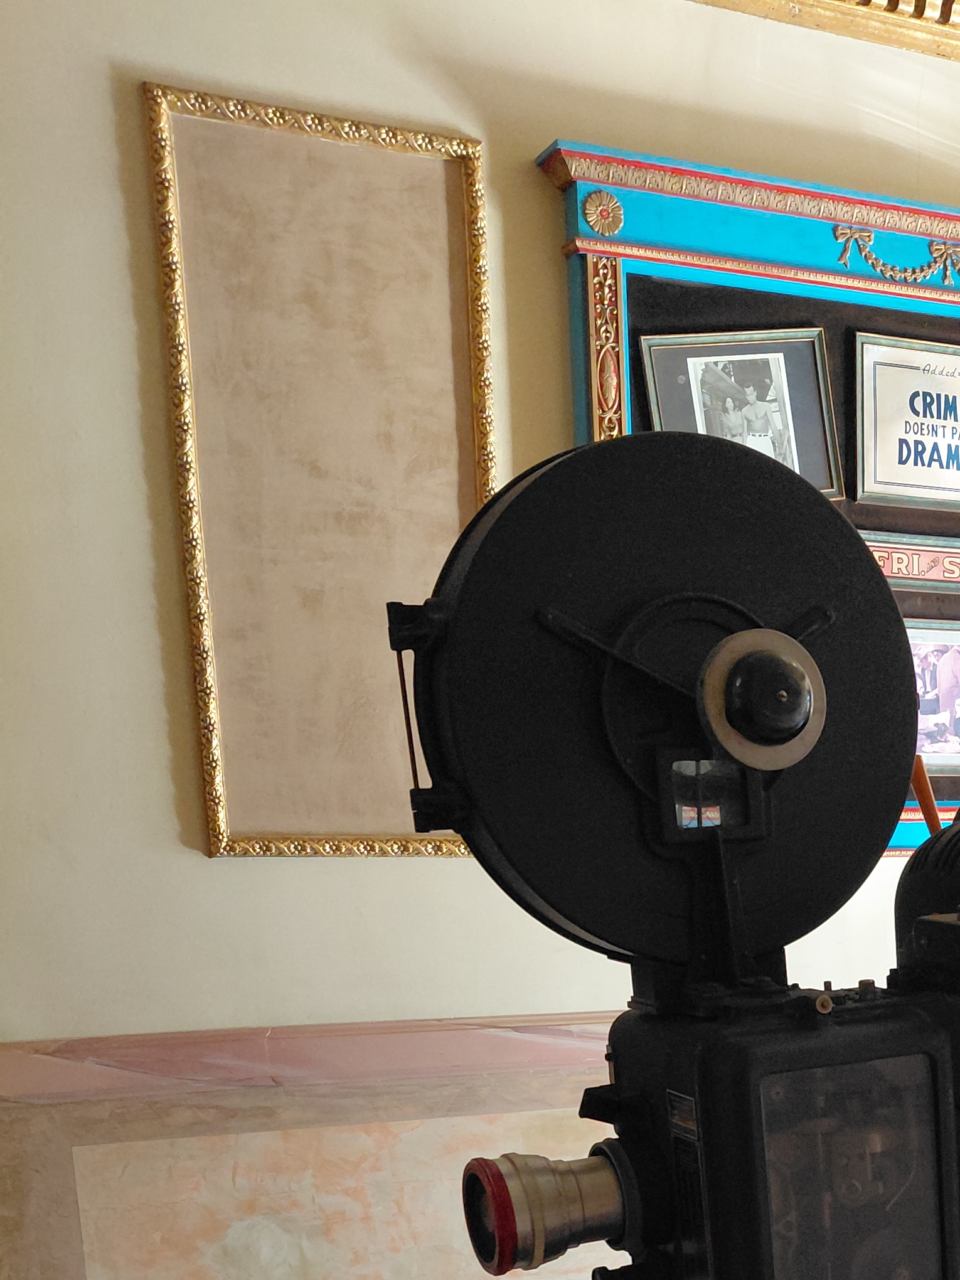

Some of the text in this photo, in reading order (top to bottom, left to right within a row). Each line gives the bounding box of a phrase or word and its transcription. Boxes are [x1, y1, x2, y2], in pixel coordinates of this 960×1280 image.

[921, 363, 958, 378] Added
[904, 420, 947, 439] DOESN'T
[871, 550, 926, 576] FRI.
